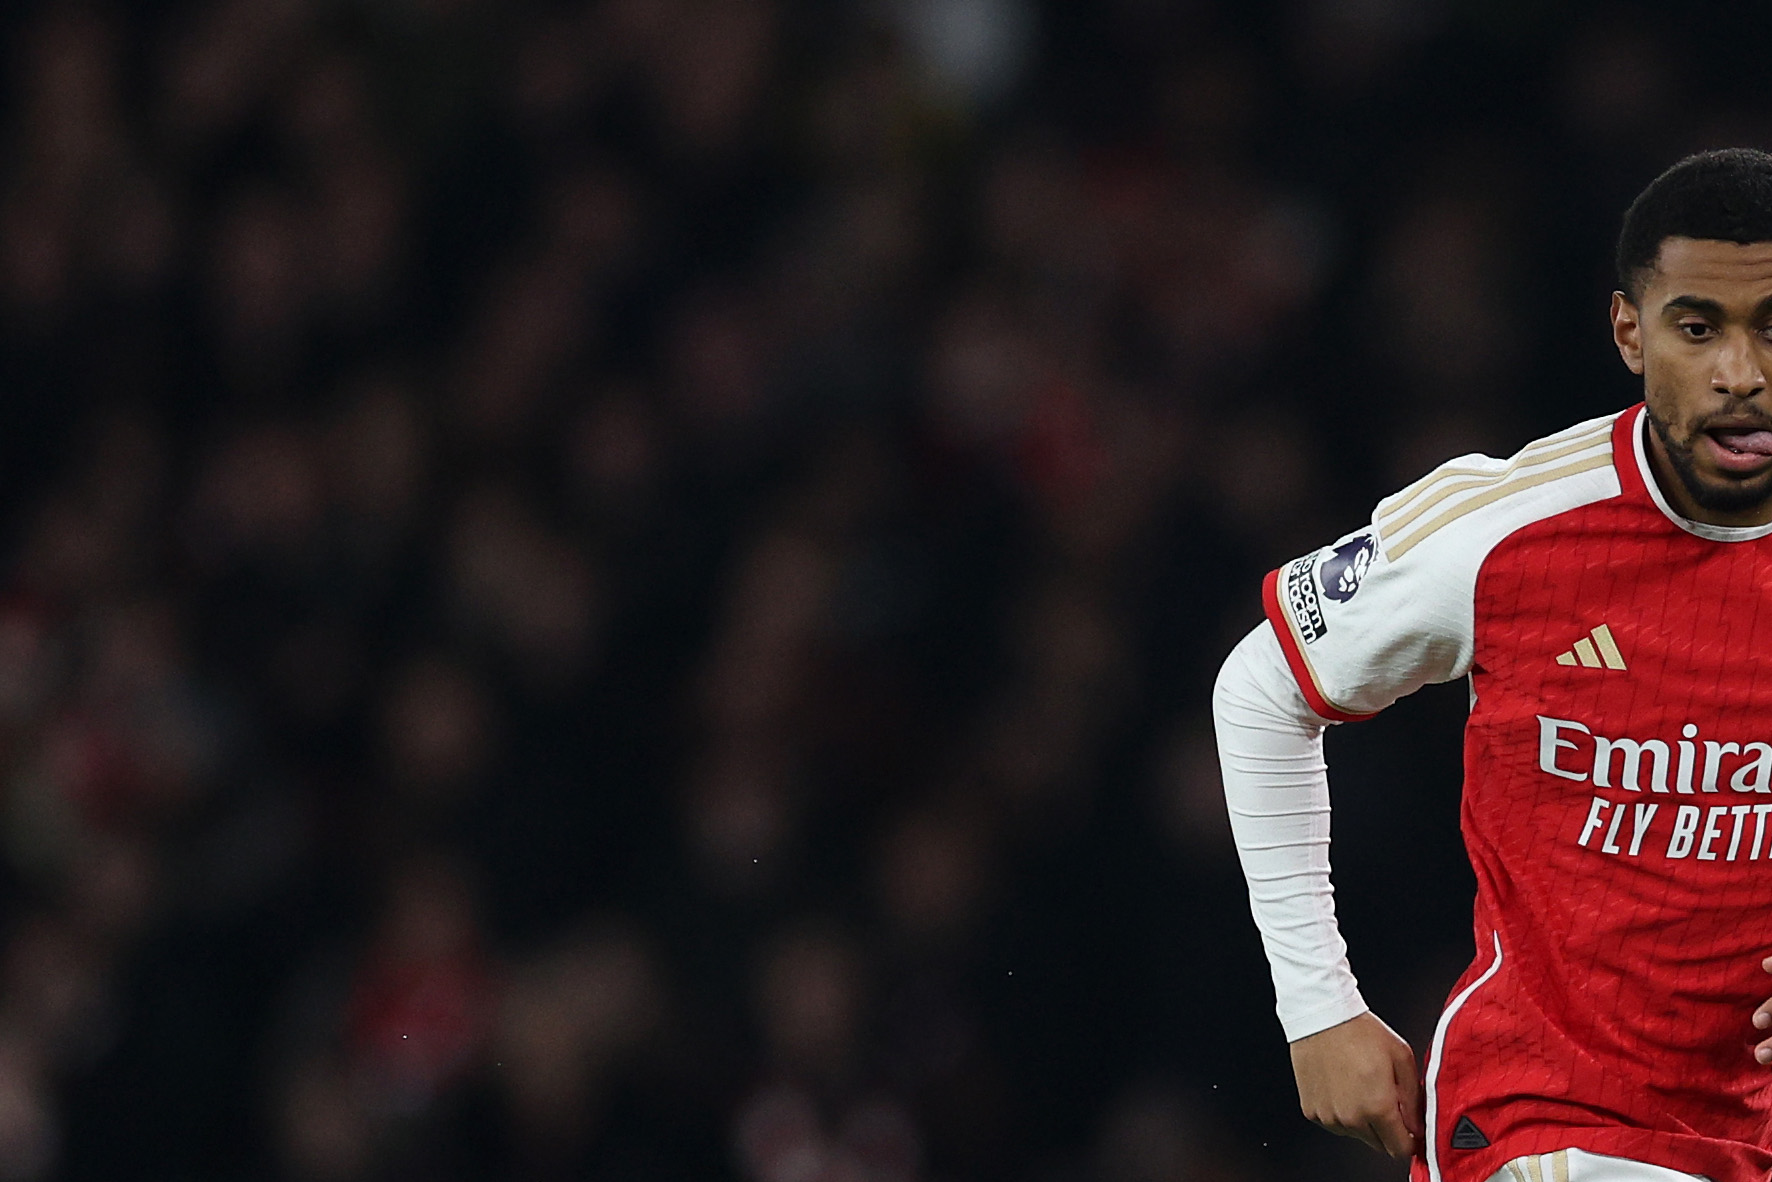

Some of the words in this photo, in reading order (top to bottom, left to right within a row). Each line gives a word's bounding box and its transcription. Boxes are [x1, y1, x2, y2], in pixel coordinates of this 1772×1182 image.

[1288, 577, 1317, 643] racism
[1299, 572, 1322, 629] room
[1577, 796, 1659, 857] FLY
